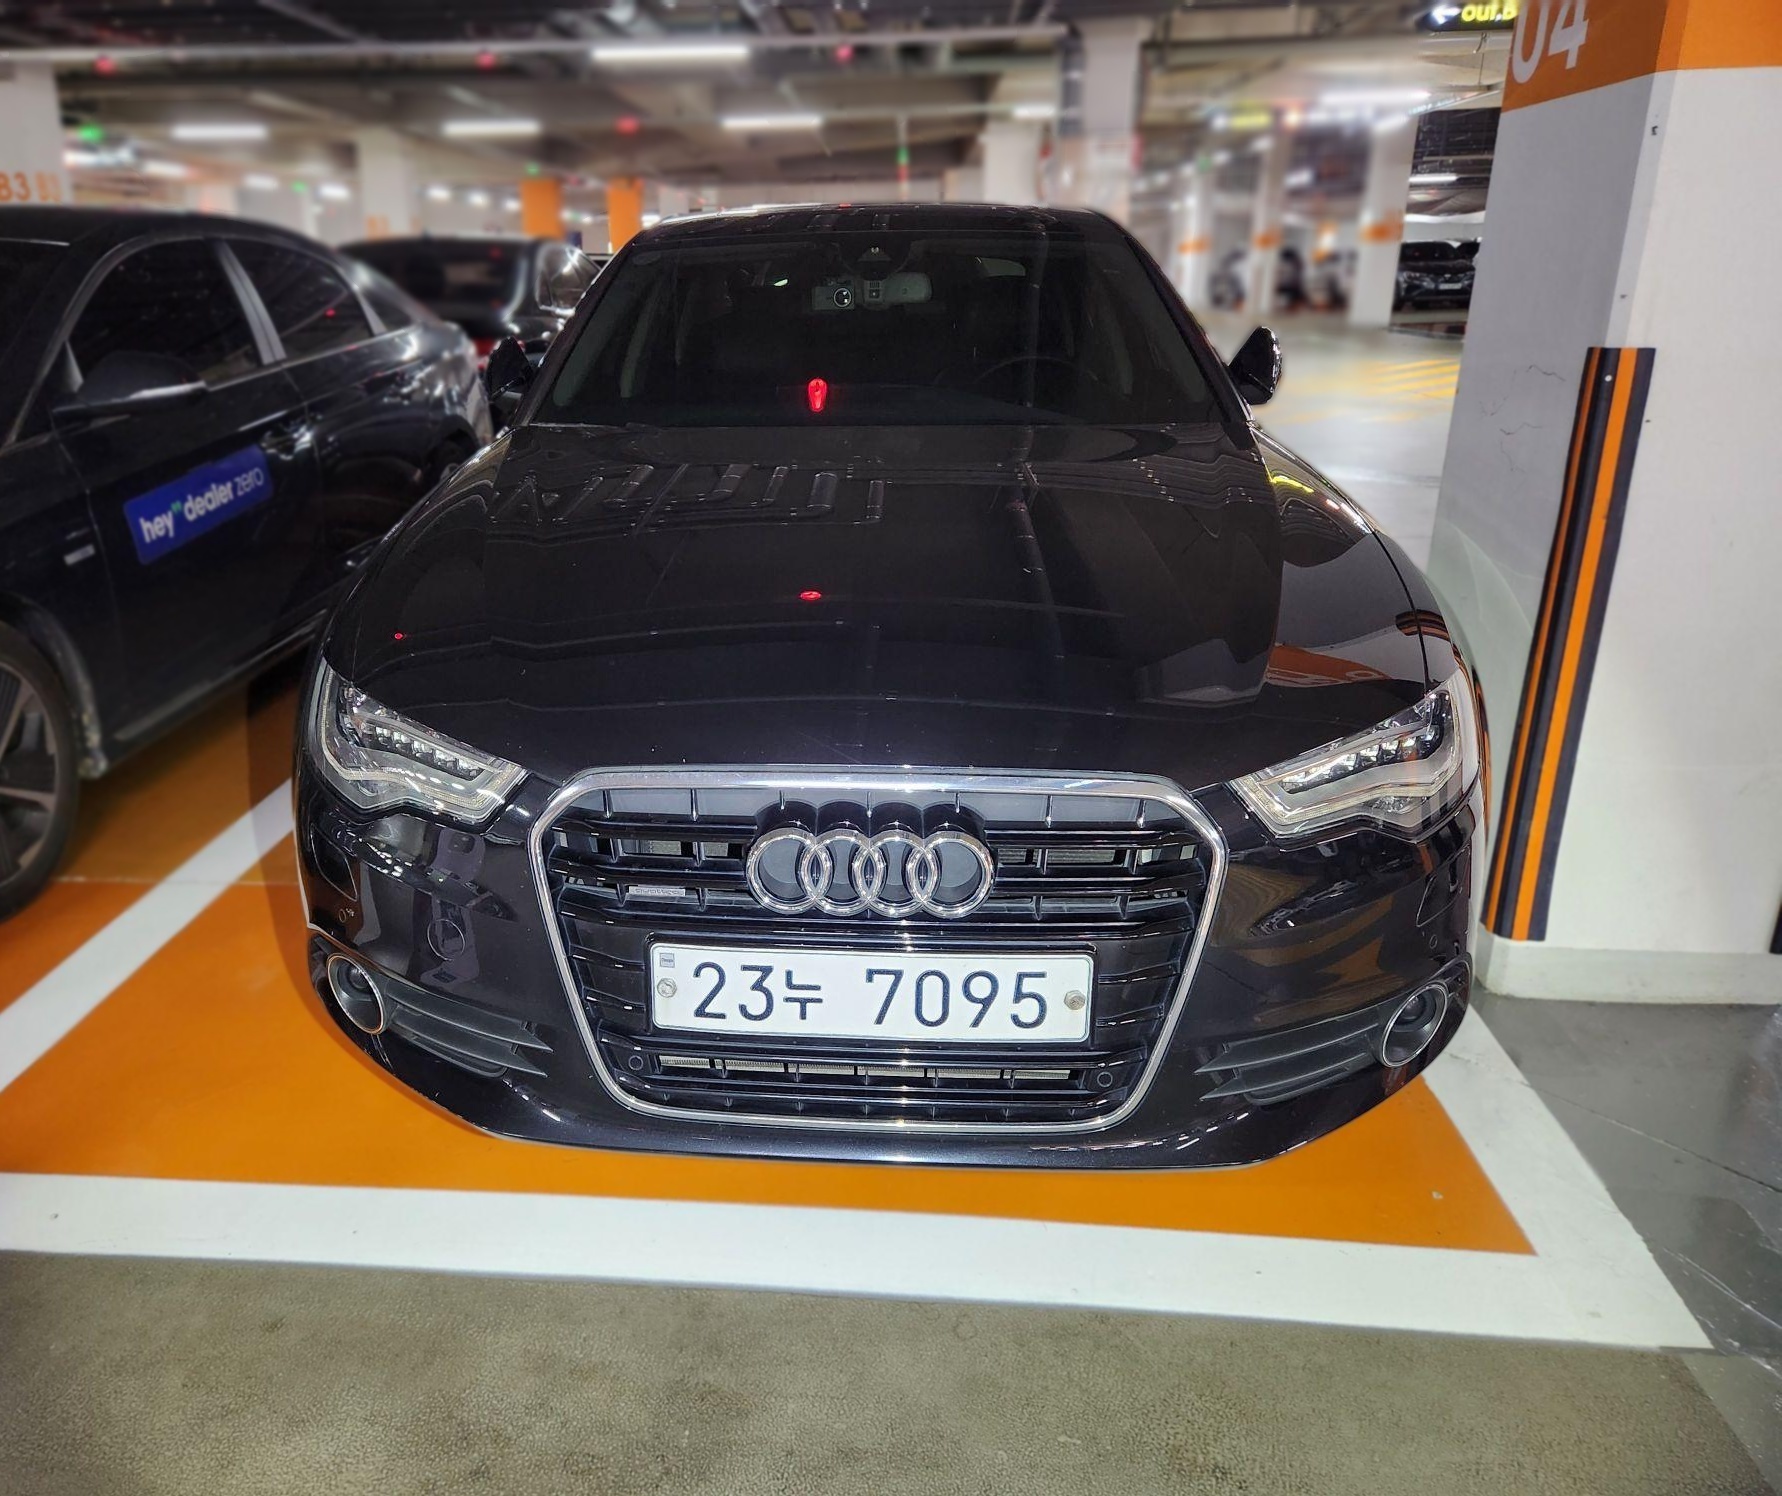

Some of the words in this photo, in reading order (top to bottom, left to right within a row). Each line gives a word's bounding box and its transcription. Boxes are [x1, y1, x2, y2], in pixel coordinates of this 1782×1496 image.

[138, 510, 174, 543] hey
[183, 480, 234, 521] dealer
[233, 467, 265, 496] zero
[692, 961, 824, 1022] 23누
[865, 967, 1049, 1030] 7095
